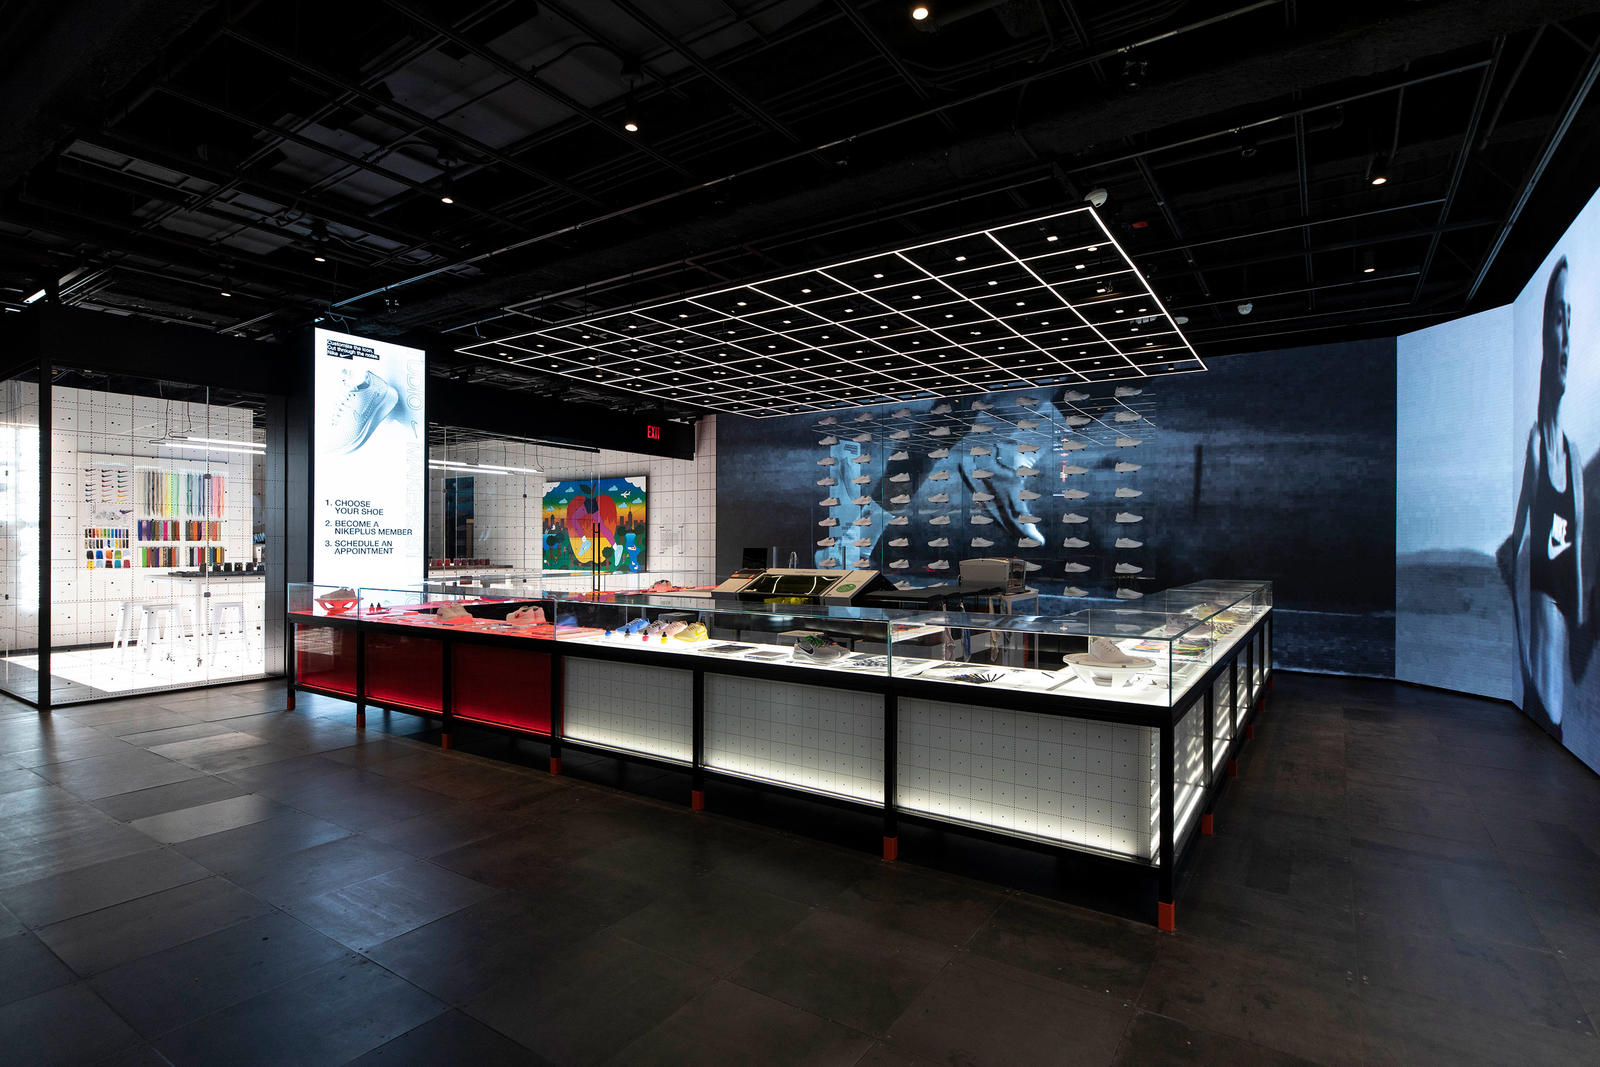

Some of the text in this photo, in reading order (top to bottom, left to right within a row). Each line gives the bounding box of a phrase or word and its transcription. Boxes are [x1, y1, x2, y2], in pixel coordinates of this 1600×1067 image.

[337, 347, 356, 356] through
[647, 425, 660, 440] EXIT
[334, 499, 371, 507] CHOOSE
[335, 507, 384, 516] YOUR SHOE
[334, 520, 371, 528] BECOME
[334, 528, 413, 536] NIKEPLUS MEMBER
[334, 547, 394, 555] APPOINTMENT
